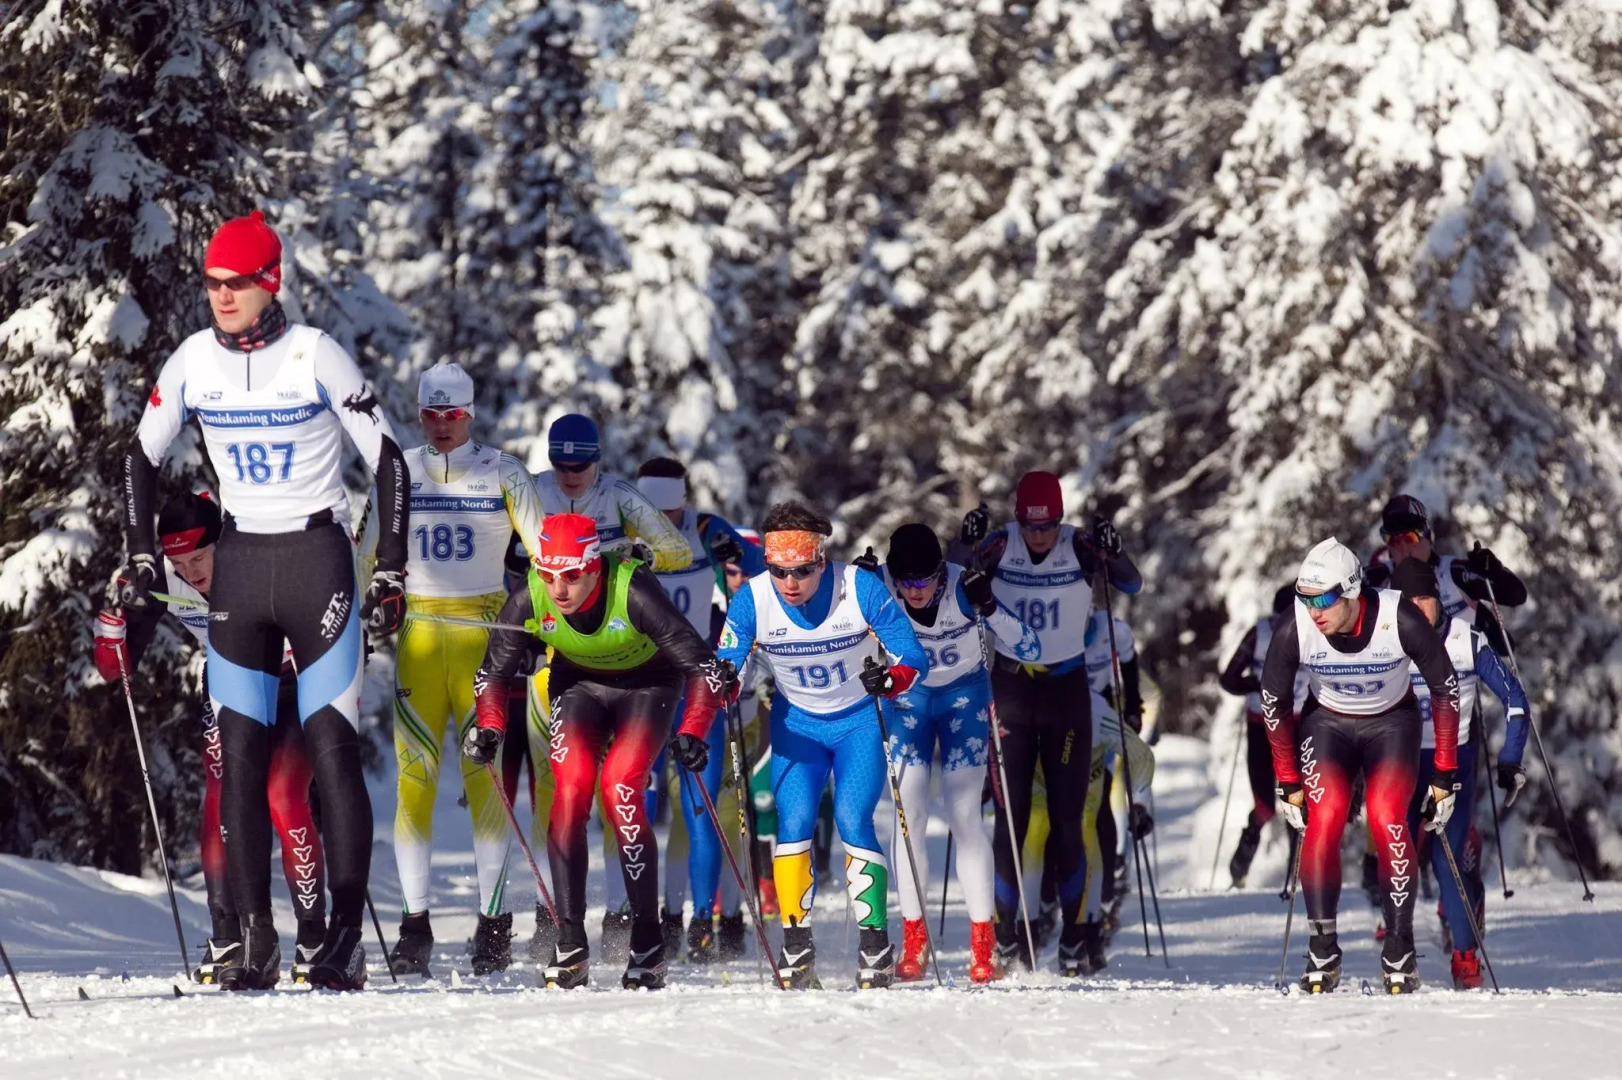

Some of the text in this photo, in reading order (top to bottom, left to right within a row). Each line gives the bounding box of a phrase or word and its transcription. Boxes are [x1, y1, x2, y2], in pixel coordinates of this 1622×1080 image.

[271, 408, 312, 423] Nordic
[225, 441, 296, 485] 187
[460, 499, 495, 509] Nordic
[414, 523, 476, 562] 183
[1050, 573, 1075, 584] Nordic
[325, 595, 350, 643] NORDIC
[1014, 597, 1060, 632] 181
[790, 659, 849, 689] 191
